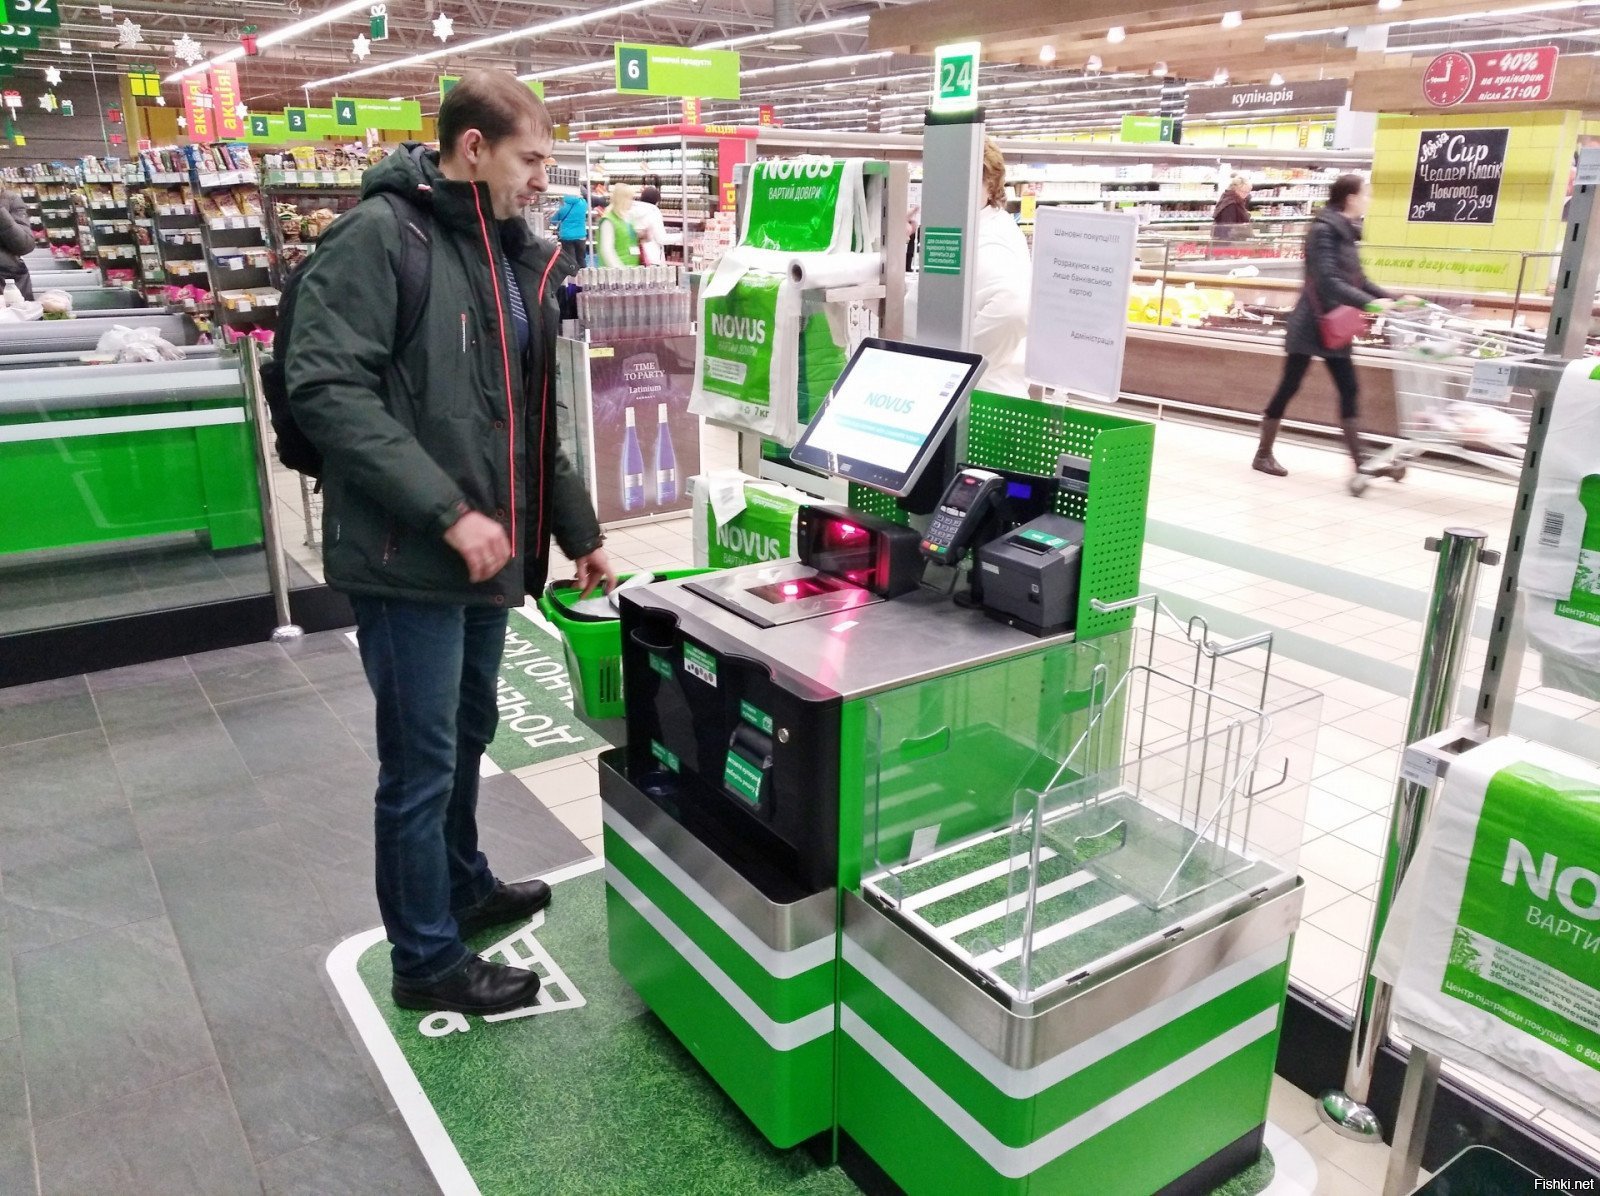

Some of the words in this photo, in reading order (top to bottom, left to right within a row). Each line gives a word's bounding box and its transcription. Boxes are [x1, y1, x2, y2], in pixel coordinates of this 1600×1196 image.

[627, 60, 640, 79] 6
[942, 61, 971, 92] 24
[1232, 87, 1294, 107] кулінарія
[1502, 85, 1541, 100] 21:00
[294, 115, 302, 126] 3
[342, 107, 351, 119] 4
[256, 122, 264, 132] 2
[1162, 126, 1169, 136] 5
[762, 159, 832, 180] NOVUS
[768, 183, 795, 201] ВАРТИЙ
[1430, 183, 1479, 199] Новгород
[711, 313, 766, 344] NOVUS
[633, 361, 656, 371] TIME
[624, 373, 637, 381] TO
[637, 370, 666, 380] PARTY
[629, 384, 662, 394] Latinium
[864, 392, 915, 415] NOVUS
[716, 523, 780, 560] NOVUS
[1558, 603, 1586, 618] Центр
[1491, 961, 1527, 982] NOVUS
[1528, 979, 1540, 988] за
[1542, 985, 1572, 1004] чисте
[1489, 969, 1550, 1003] Збережемо
[1551, 1000, 1599, 1028] зелений
[1445, 980, 1475, 999] Центр
[1475, 993, 1525, 1023] підтримки
[1575, 1043, 1584, 1053] 0
